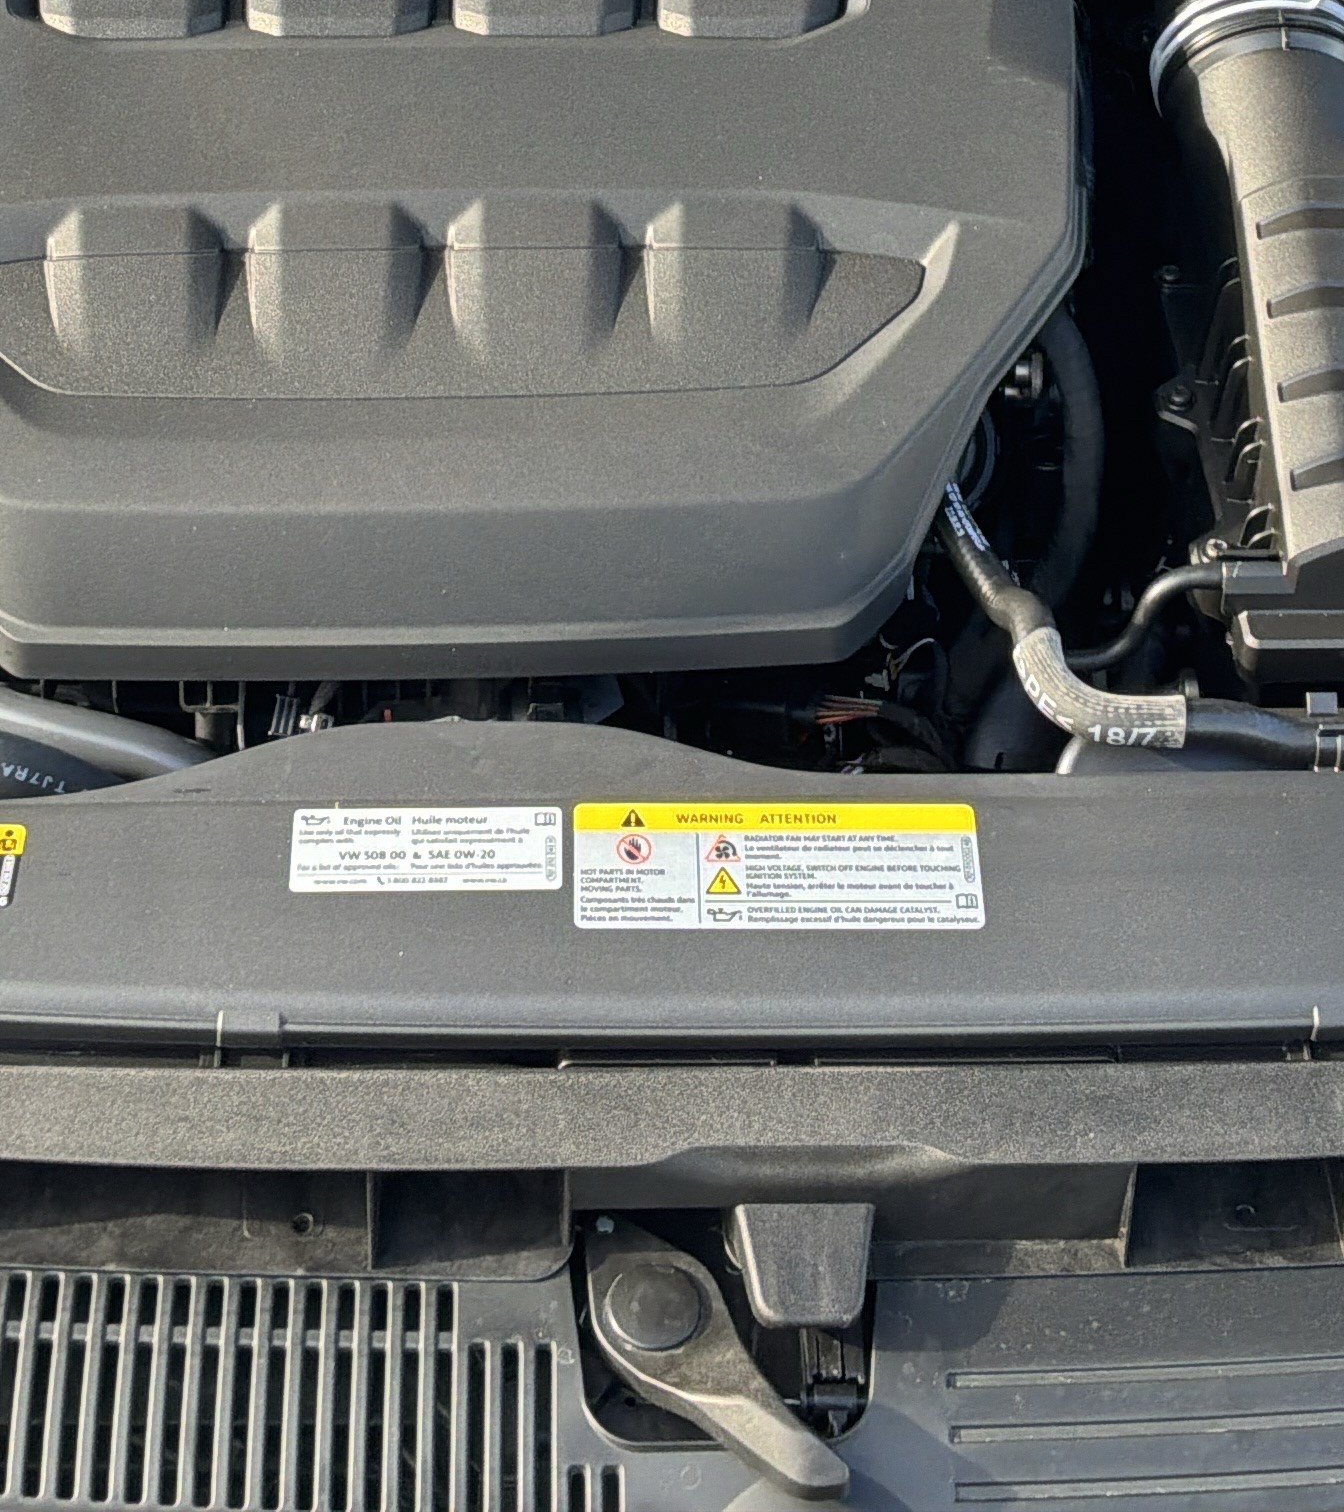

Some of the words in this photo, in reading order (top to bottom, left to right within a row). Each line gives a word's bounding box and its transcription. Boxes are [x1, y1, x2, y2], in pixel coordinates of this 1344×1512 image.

[342, 816, 383, 827] Engine
[384, 816, 402, 826] Oil
[411, 815, 443, 825] Huile
[445, 816, 488, 825] moteur
[675, 813, 744, 825] WARNING
[759, 813, 838, 825] ATTENTION
[338, 850, 362, 861] VW
[363, 850, 387, 861] 508
[389, 850, 407, 861] 00
[428, 850, 451, 860] SAE
[598, 868, 624, 876] PARTS
[855, 864, 885, 873] ENGINE
[886, 864, 918, 873] BEFORE
[919, 864, 962, 873] TOUCHING
[580, 885, 613, 894] MOVING
[747, 906, 797, 914] OVERFILLED
[798, 906, 828, 914] ENGINE
[844, 906, 863, 914] CAN
[863, 906, 899, 914] DAMAGE
